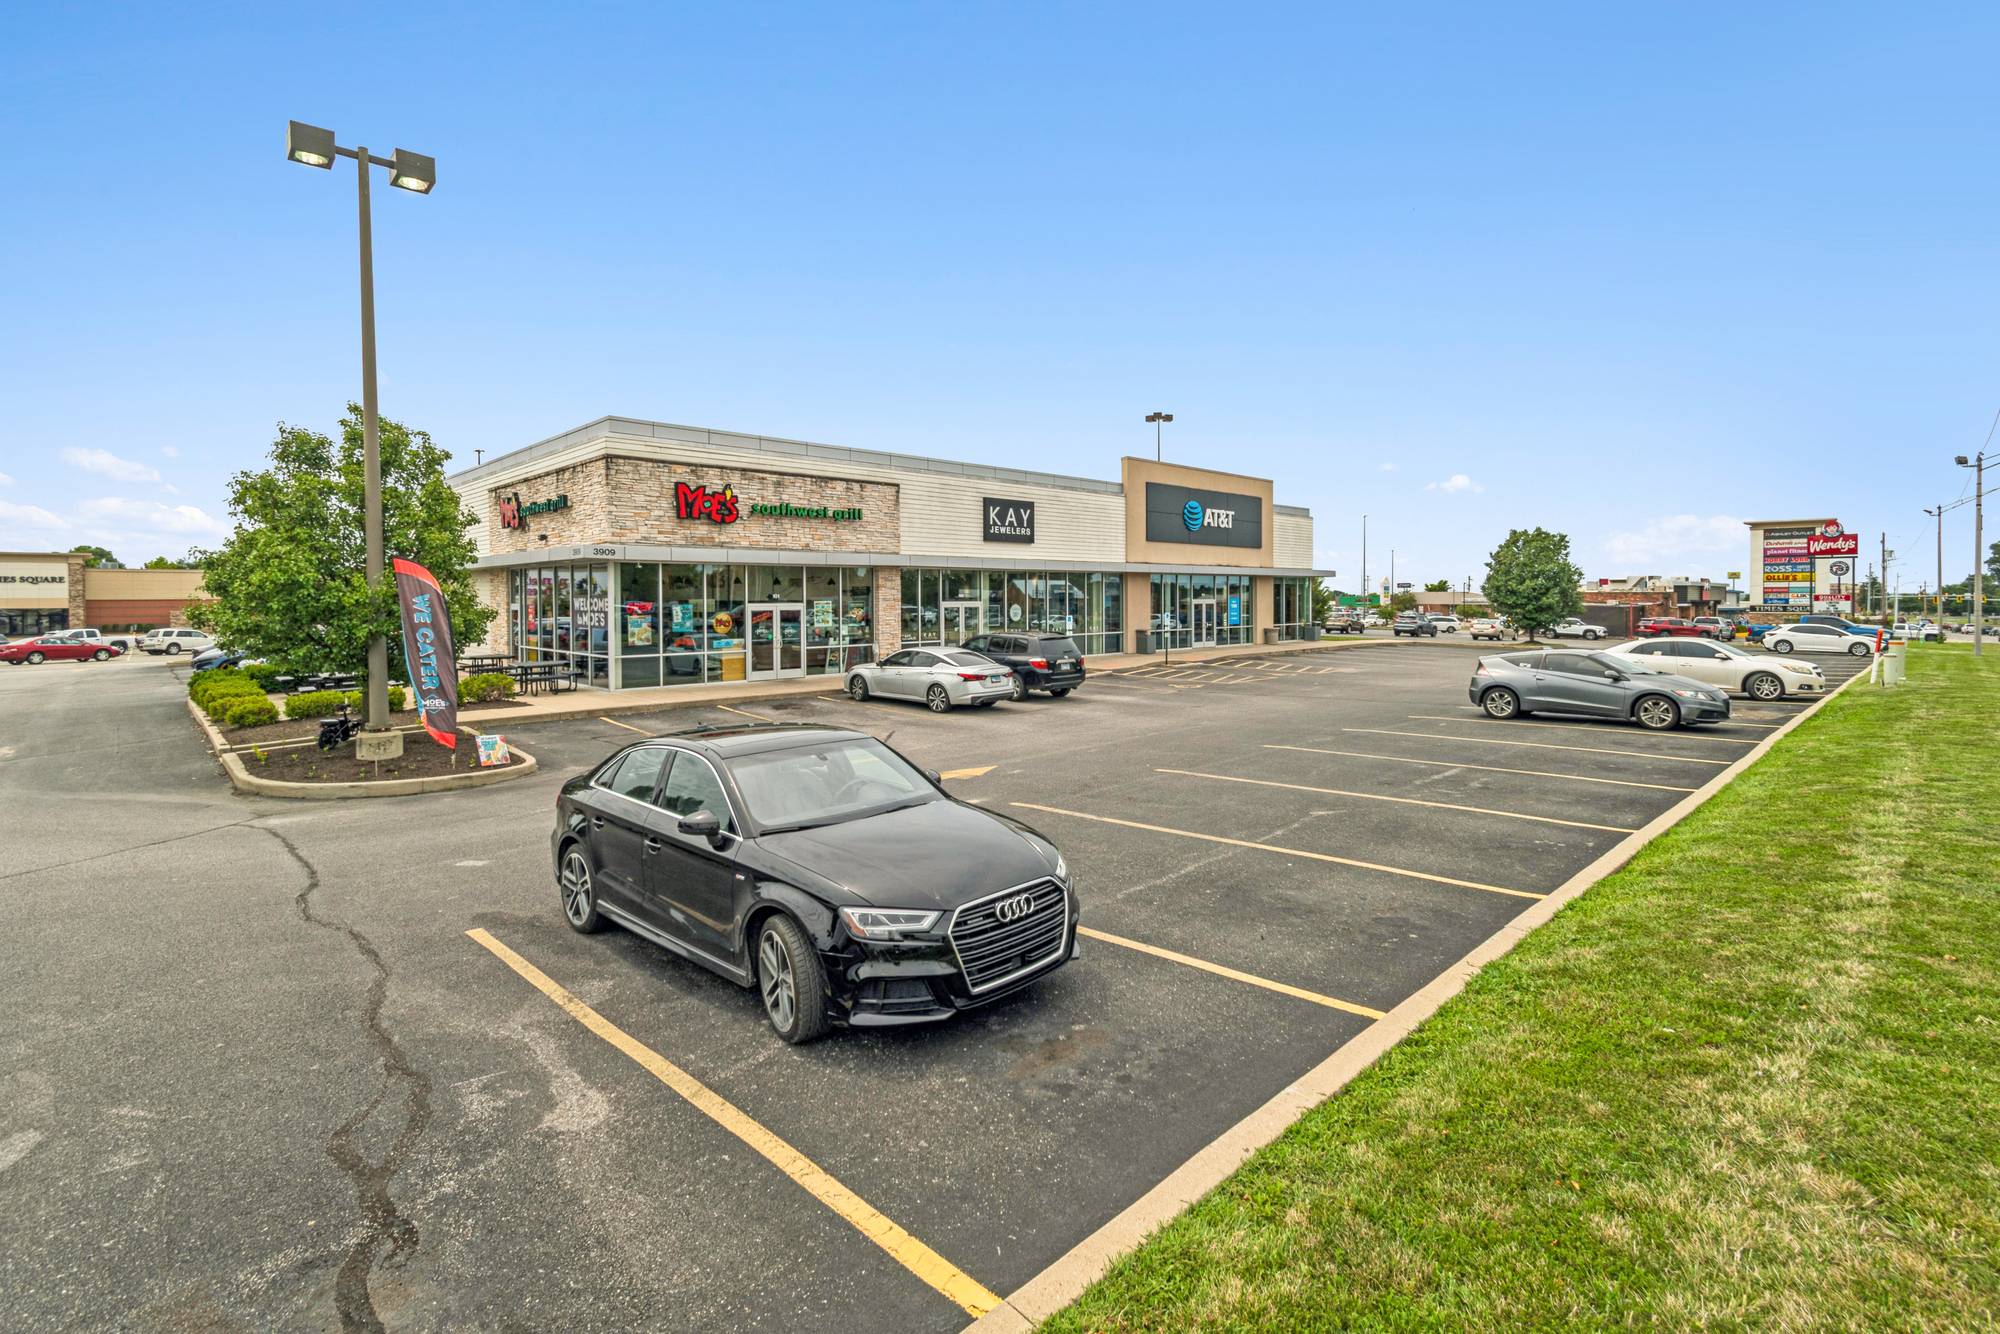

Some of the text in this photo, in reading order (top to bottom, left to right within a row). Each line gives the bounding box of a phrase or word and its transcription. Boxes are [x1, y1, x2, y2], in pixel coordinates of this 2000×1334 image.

[751, 502, 829, 520] southwest
[832, 508, 863, 521] grill
[989, 506, 1031, 527] KAY
[1203, 507, 1235, 529] AT&T
[989, 526, 1031, 536] JEWELERS
[593, 547, 616, 556] 3909
[1809, 538, 1855, 553] Wendy's
[1764, 565, 1792, 573] ROSS
[19, 576, 65, 584] SQUARE
[412, 594, 432, 623] WE
[573, 598, 608, 611] WELCOME
[416, 627, 439, 690] CATER
